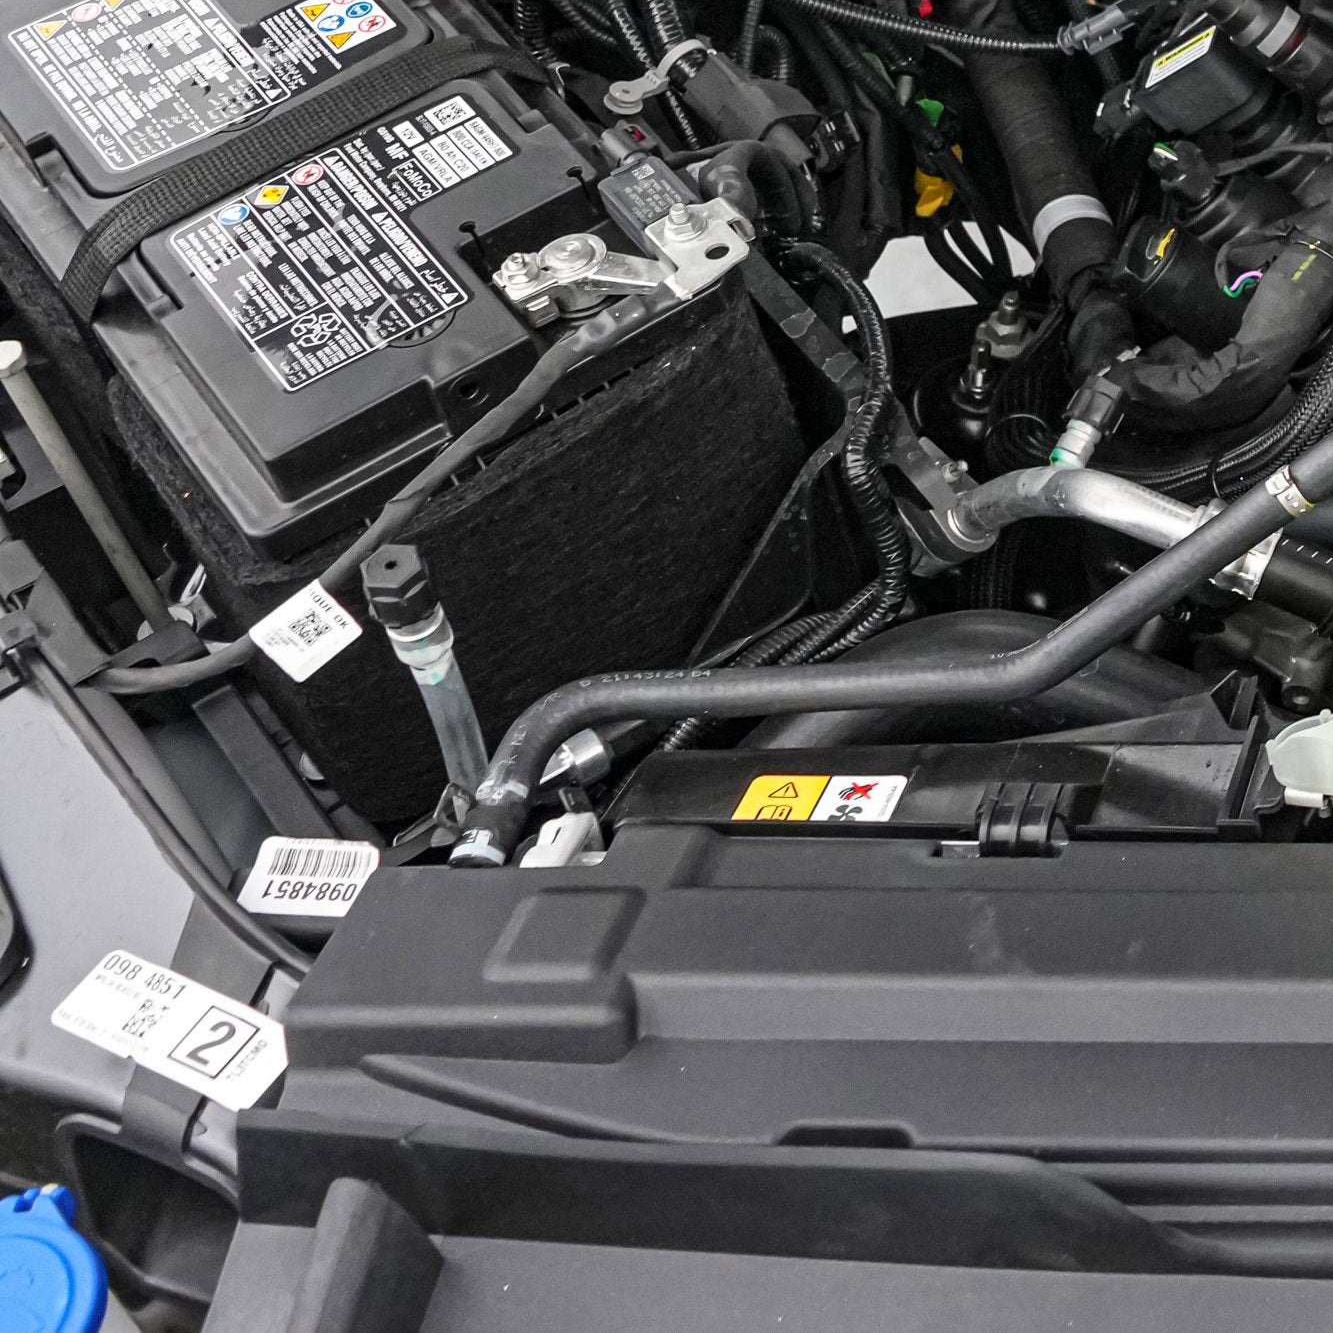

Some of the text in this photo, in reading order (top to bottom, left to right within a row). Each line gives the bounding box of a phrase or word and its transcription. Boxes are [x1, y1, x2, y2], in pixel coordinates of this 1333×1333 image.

[399, 127, 417, 141] 12V
[383, 141, 410, 162] MF
[417, 147, 455, 183] AGM/VRLA
[436, 140, 470, 172] 80 Ah C20
[397, 161, 437, 198] FoMoCo
[262, 879, 359, 902] 0984851
[103, 953, 143, 982] 098
[144, 972, 188, 1001] 4851
[187, 1020, 237, 1068] 2
